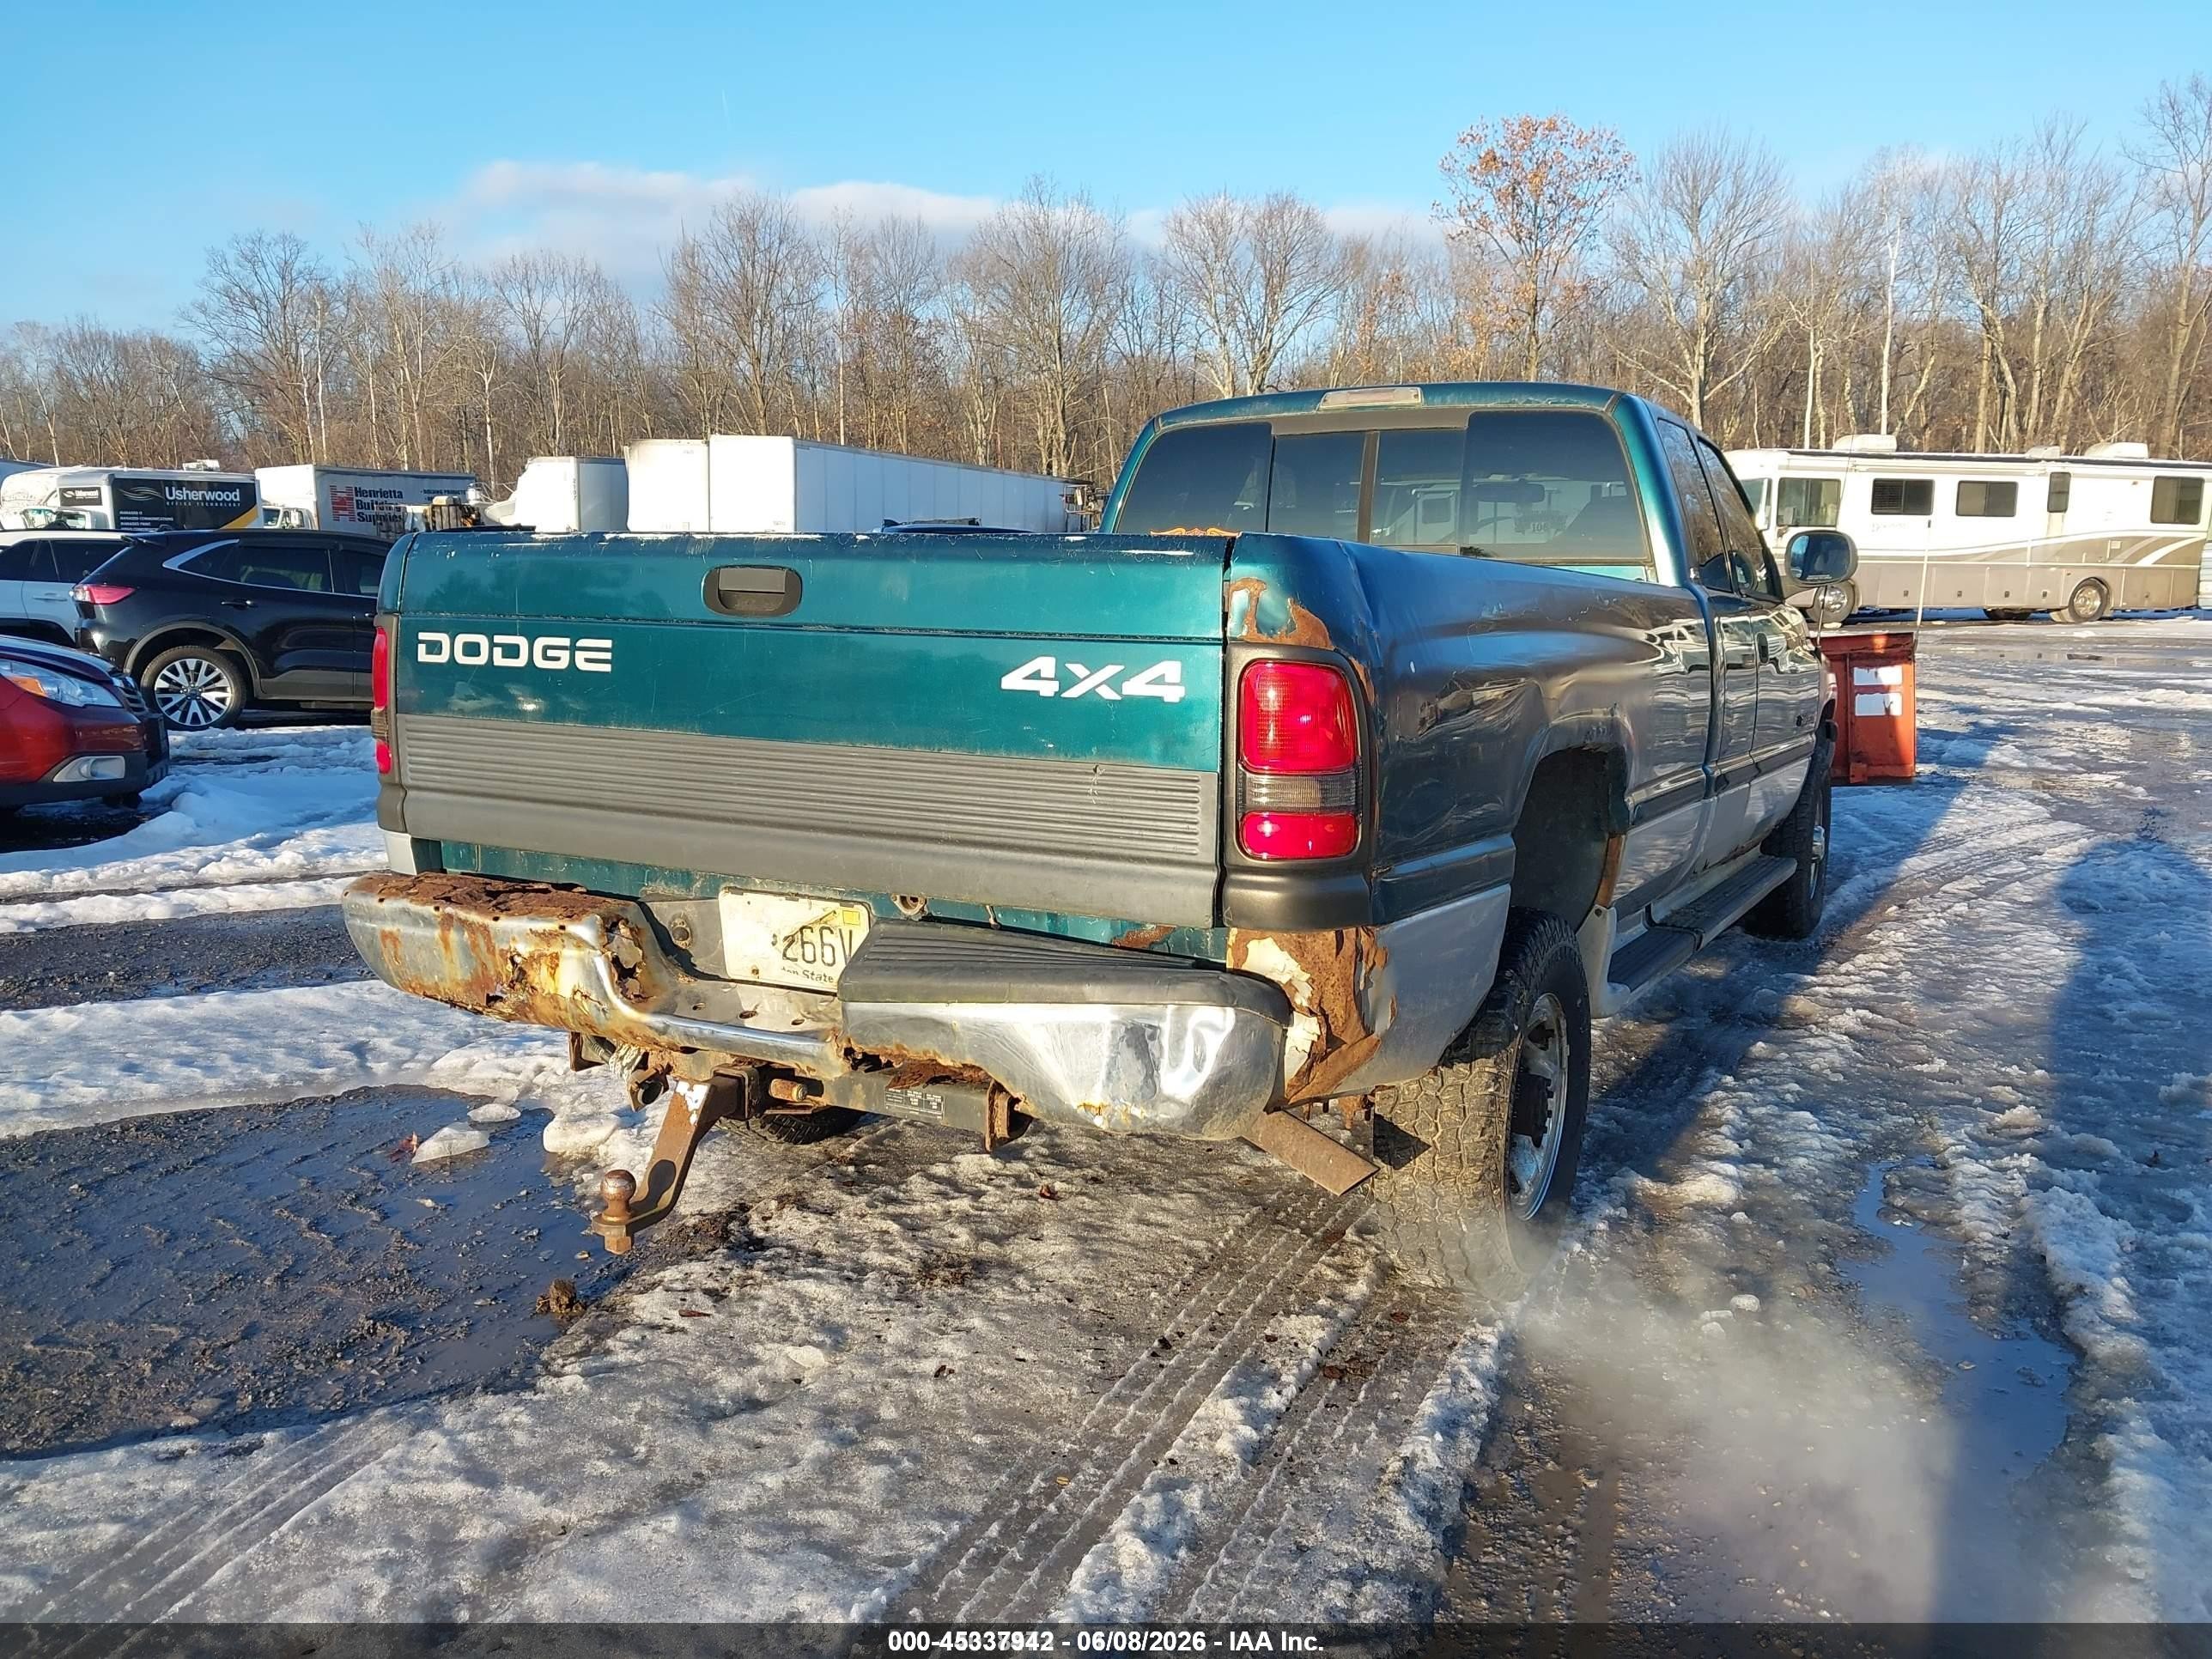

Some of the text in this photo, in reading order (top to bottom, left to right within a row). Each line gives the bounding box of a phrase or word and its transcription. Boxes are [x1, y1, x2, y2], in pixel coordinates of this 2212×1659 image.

[165, 486, 240, 501] Usherwood
[354, 487, 404, 499] Henrietta
[417, 631, 612, 673] DODGE
[802, 969, 835, 983] State
